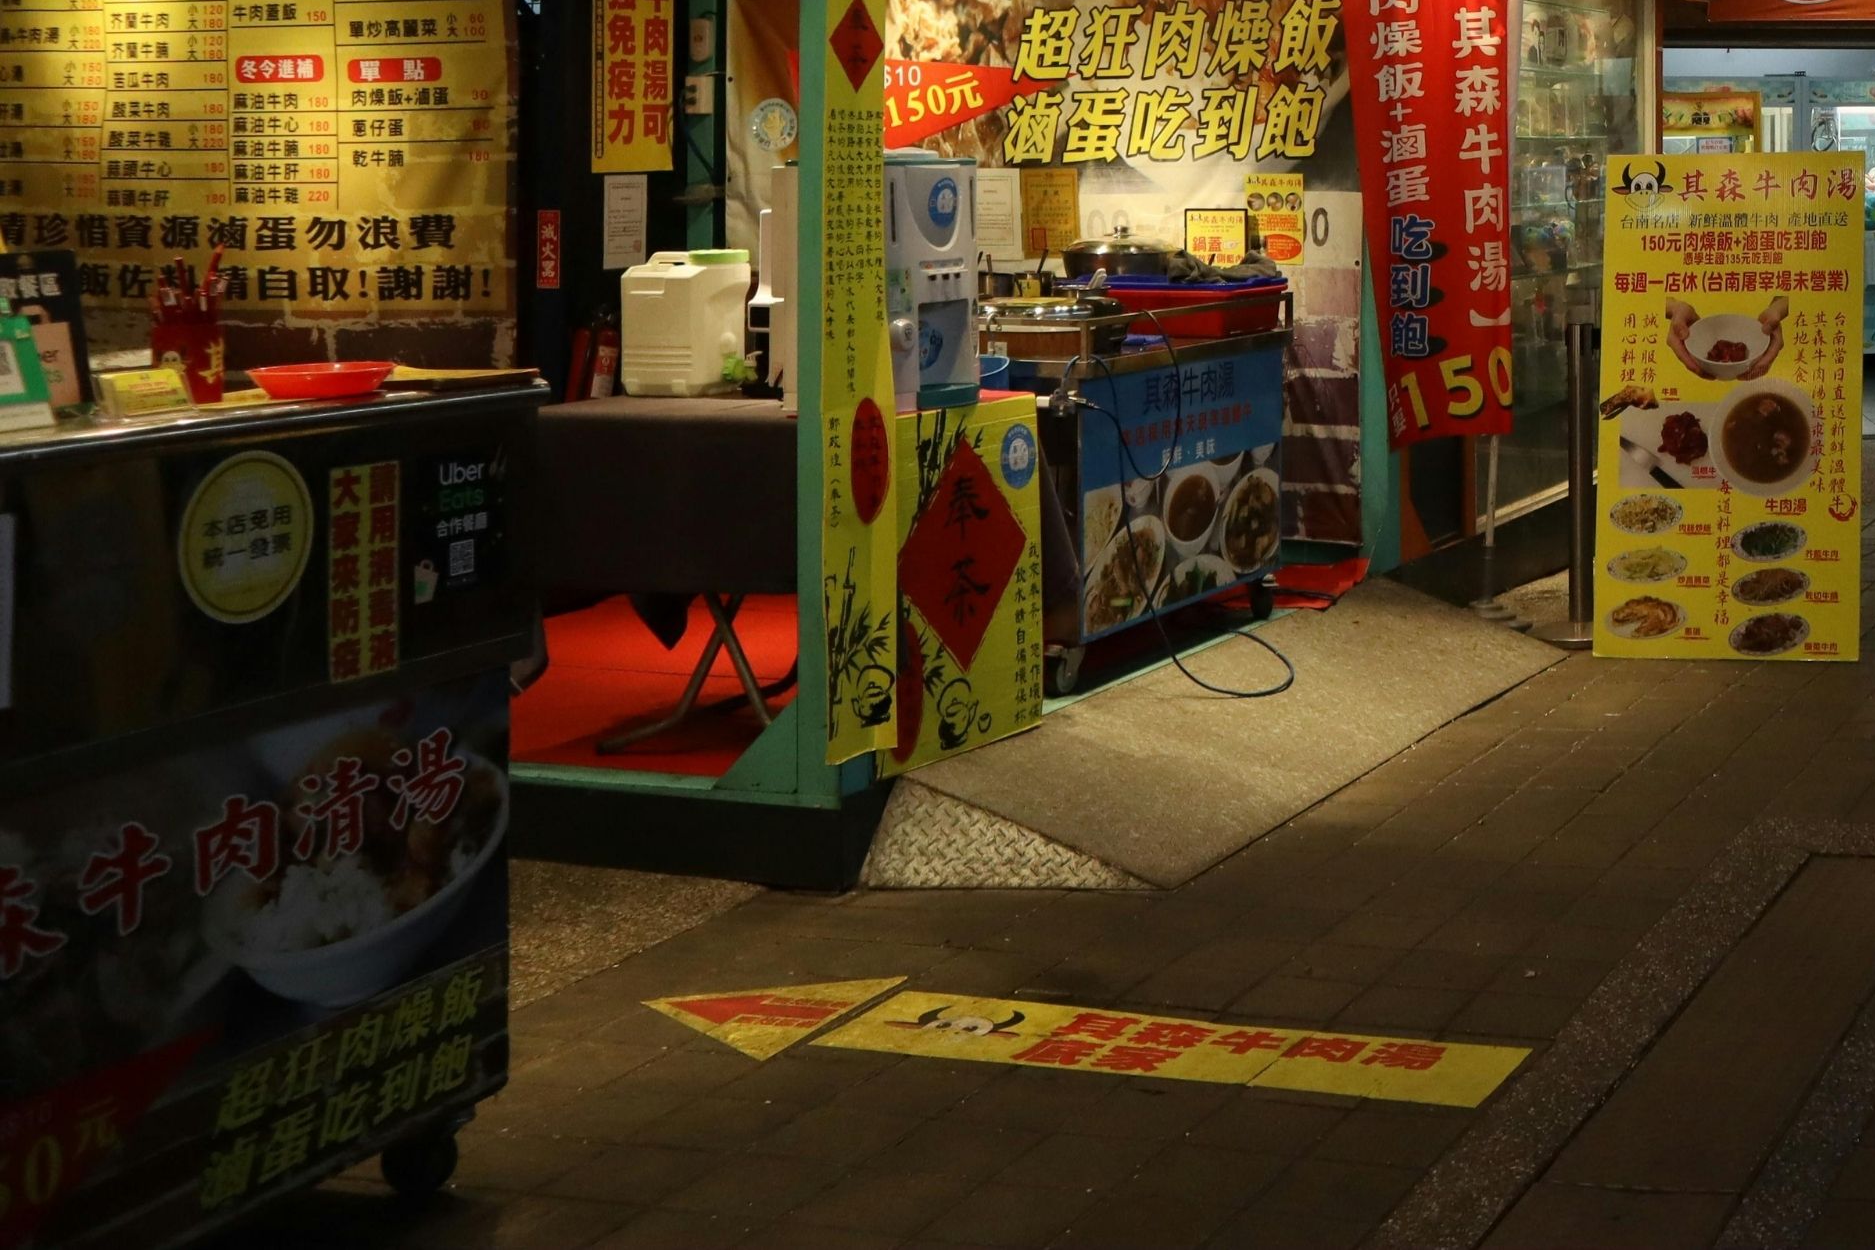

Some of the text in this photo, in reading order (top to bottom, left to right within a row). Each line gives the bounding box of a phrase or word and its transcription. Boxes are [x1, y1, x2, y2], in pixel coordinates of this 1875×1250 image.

[349, 19, 438, 38] 單炒高麗菜
[241, 58, 314, 79] 冬令進補
[233, 93, 298, 110] 麻油牛肉
[352, 88, 449, 107] 肉燥飯+滷蛋
[886, 71, 984, 127] 150元
[233, 116, 298, 134] 麻油牛心
[1003, 84, 1328, 166] 滷蛋吃到飽
[308, 191, 329, 201] 220
[1677, 168, 1859, 202] 其森牛肉湯
[1620, 213, 1848, 229] 台南名店 新鮮溫體牛肉 產地直送
[1193, 237, 1222, 252] 鍋蓋
[1641, 230, 1827, 252] 150元肉燥飯+滷蛋吃到飽
[1614, 270, 1849, 293] 每週一店休(台南屠宰場未營業)
[1620, 313, 1637, 382] 用心料理
[1641, 313, 1658, 382] 誠心服務
[1793, 313, 1810, 383] 在地美食
[1402, 346, 1513, 431] 150
[440, 462, 485, 487] Uber
[439, 487, 484, 513] Eats
[1765, 499, 1807, 513] 牛肉湯
[204, 505, 291, 538] 本店免用
[945, 475, 991, 627] 奉茶
[1714, 480, 1733, 626] 每道料理都是幸福
[1051, 1013, 1448, 1071] 其森牛肉湯
